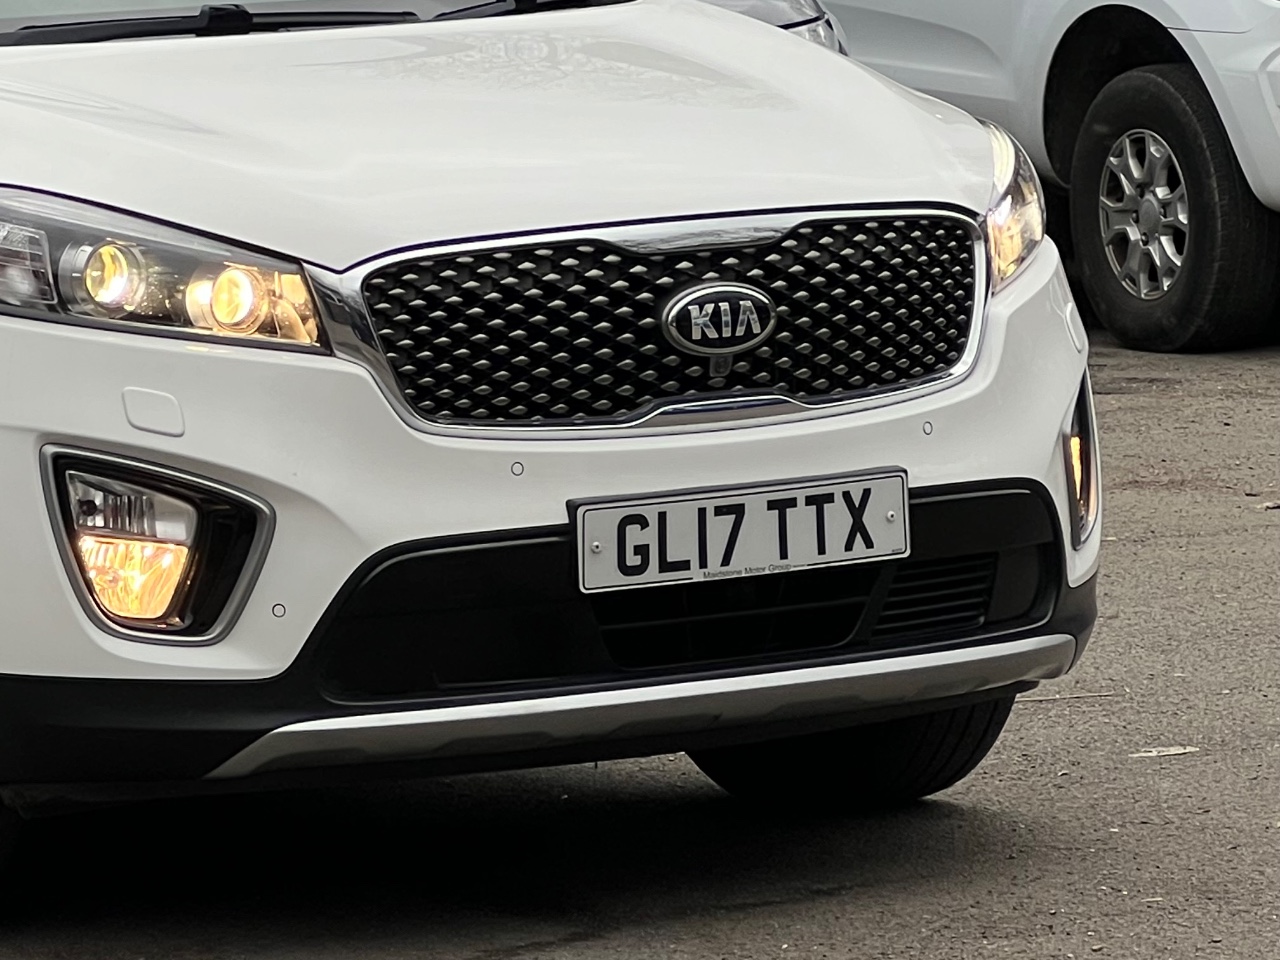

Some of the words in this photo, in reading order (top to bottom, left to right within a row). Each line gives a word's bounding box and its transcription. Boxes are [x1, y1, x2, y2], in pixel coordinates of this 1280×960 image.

[688, 300, 761, 340] KIA
[617, 503, 745, 577] GL17
[767, 488, 875, 560] TTX
[768, 564, 792, 572] Group
